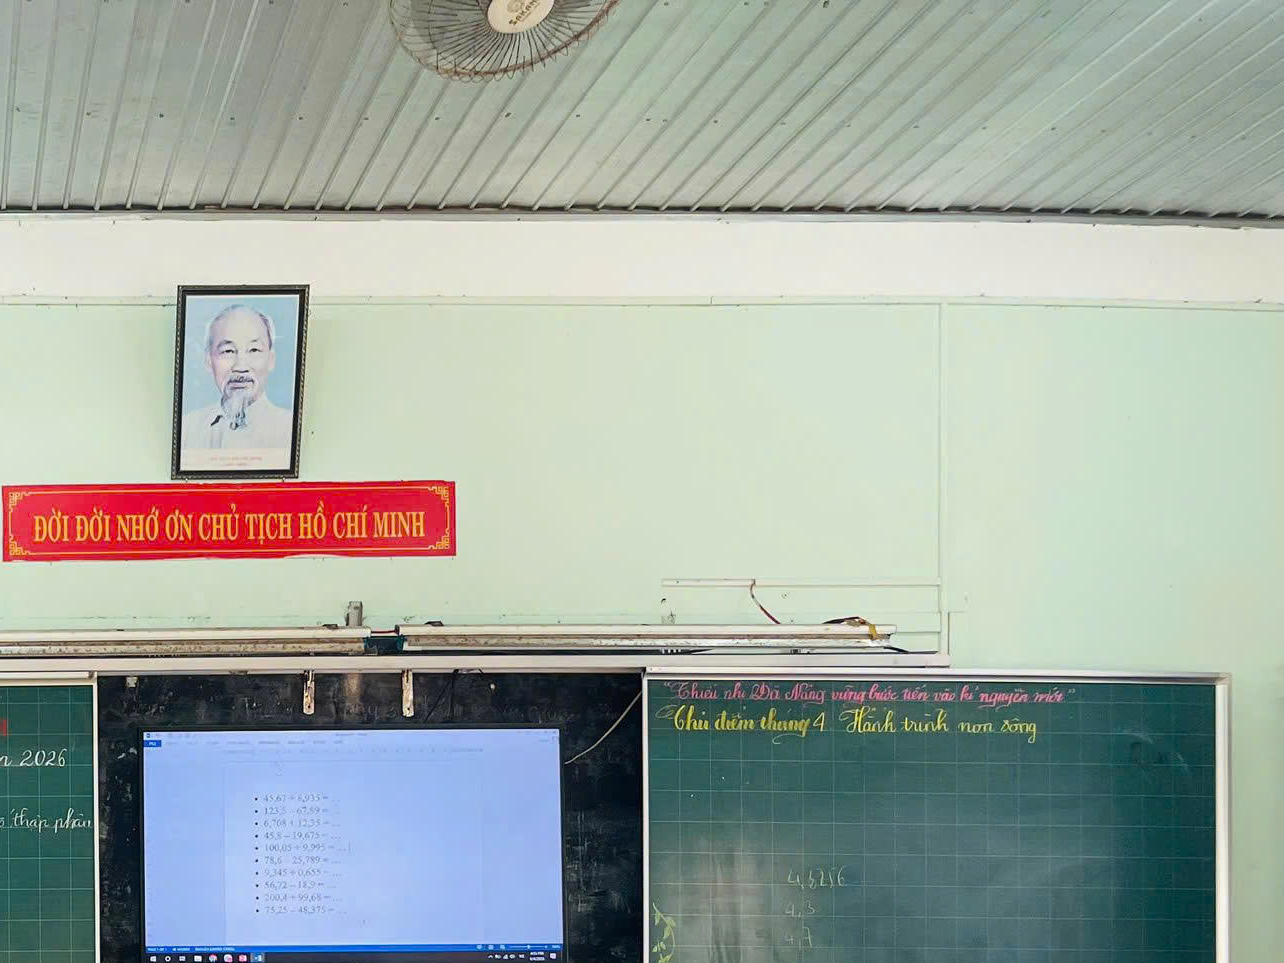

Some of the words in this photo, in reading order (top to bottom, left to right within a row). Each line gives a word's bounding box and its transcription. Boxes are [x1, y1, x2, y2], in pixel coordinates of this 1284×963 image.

[33, 507, 70, 542] ĐỜI
[75, 506, 112, 542] ĐỜI
[117, 506, 160, 541] NHỚ
[166, 509, 193, 541] ƠN
[198, 503, 239, 541] CHỦ
[245, 511, 293, 544] TỊCH
[298, 499, 327, 539] HỒ
[332, 504, 368, 538] CHÍ
[373, 511, 426, 537] MINH
[813, 711, 825, 732] 4
[958, 720, 994, 733] non
[1001, 718, 1037, 743] sông
[19, 748, 68, 767] 2026
